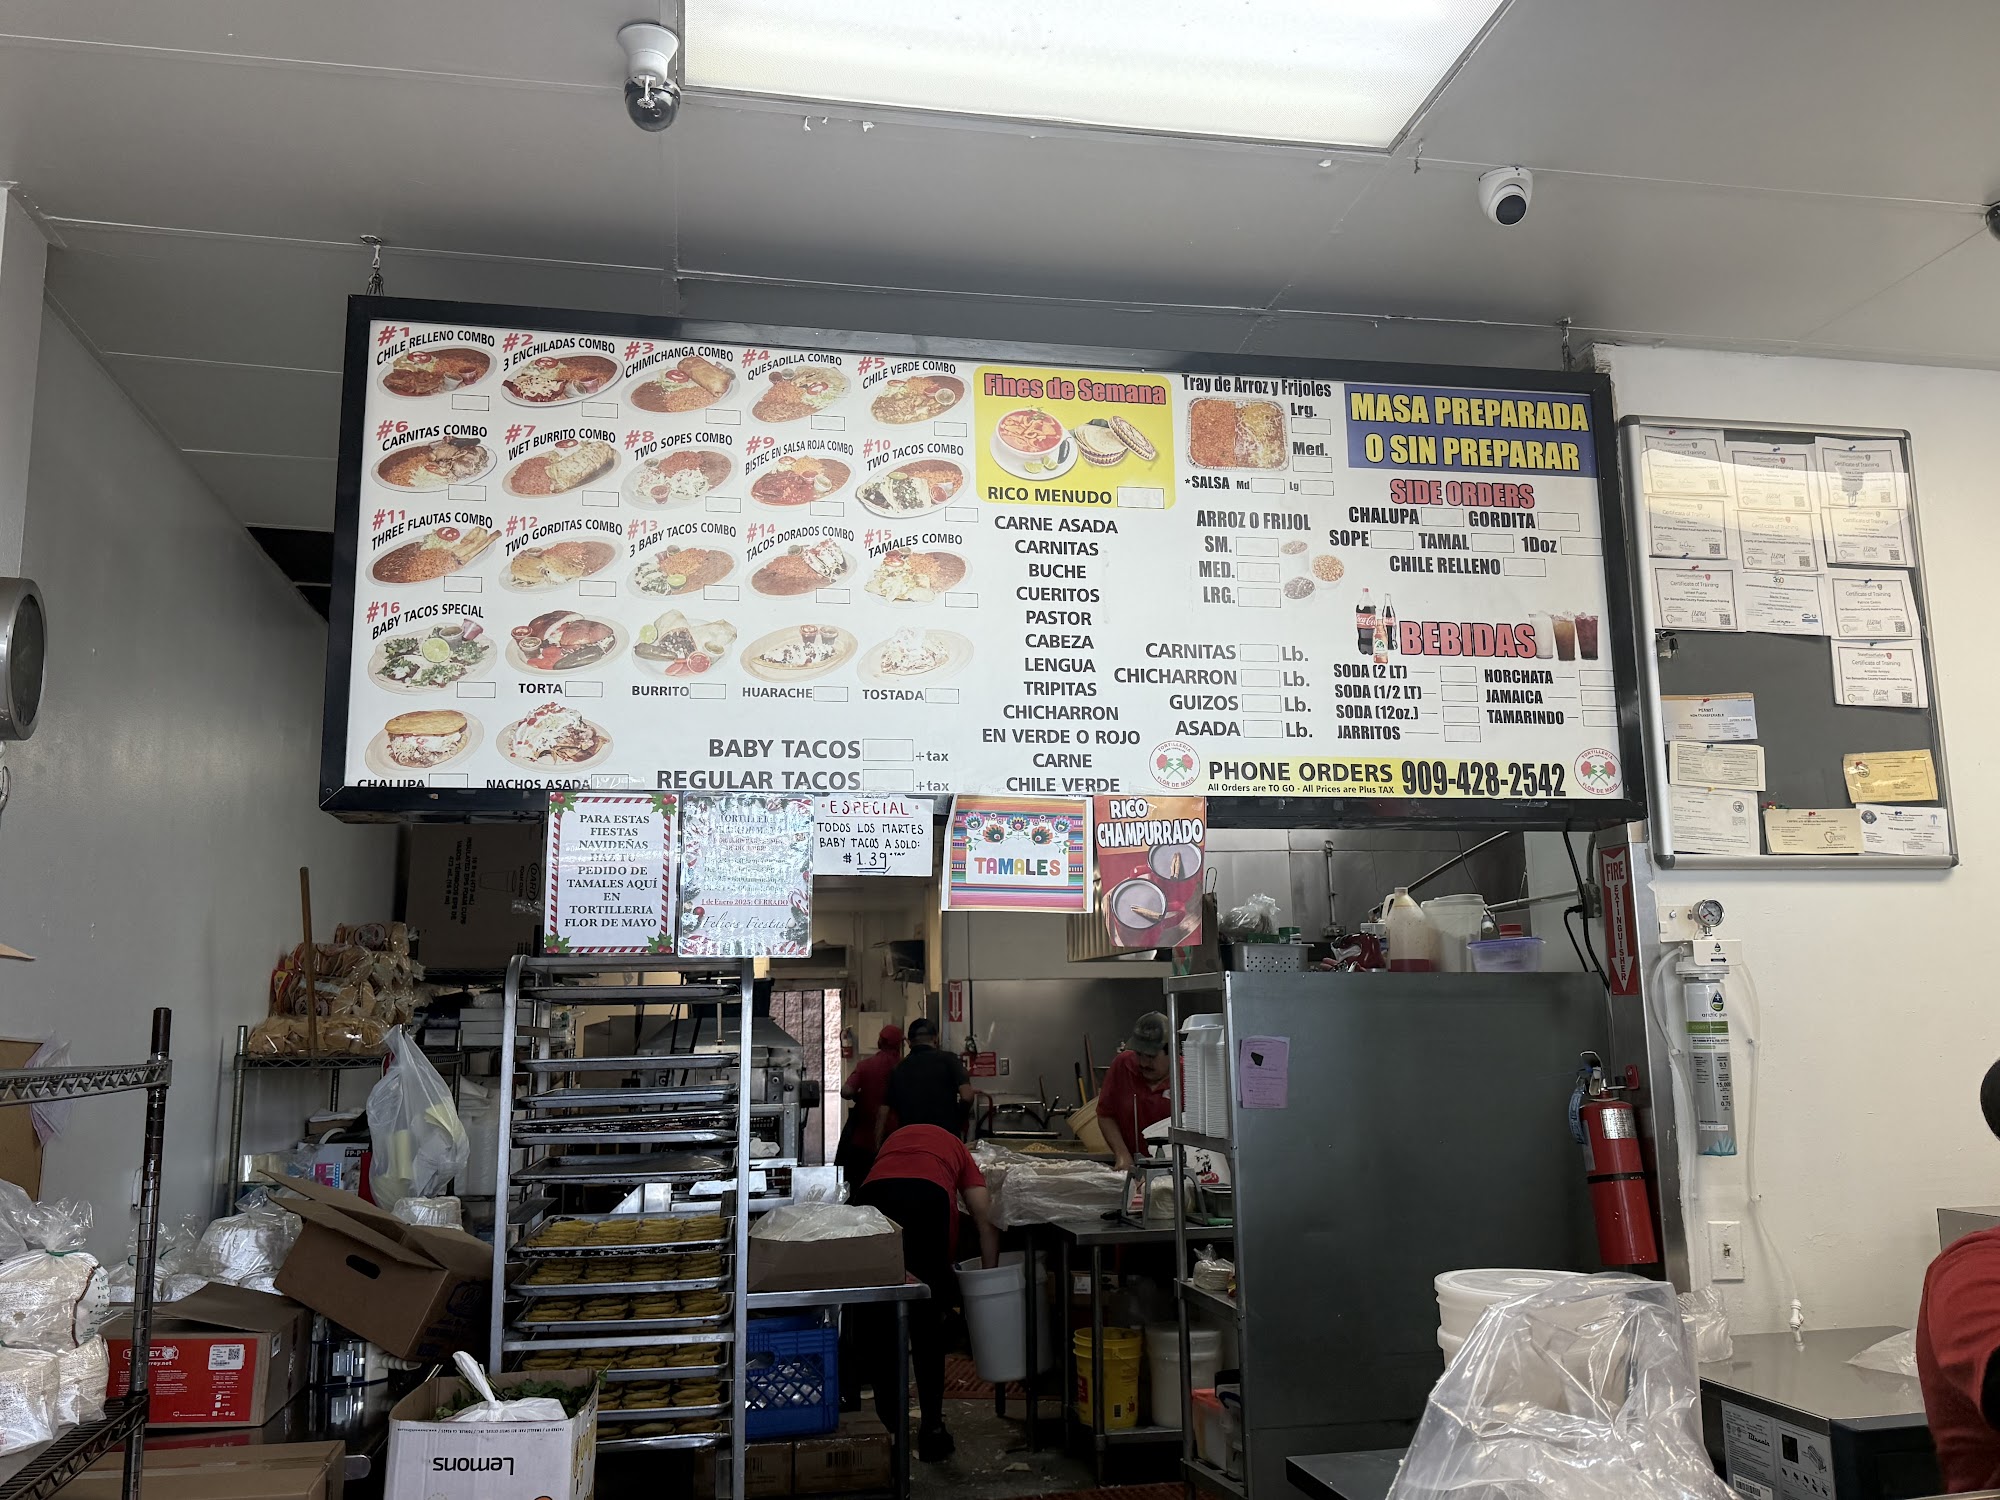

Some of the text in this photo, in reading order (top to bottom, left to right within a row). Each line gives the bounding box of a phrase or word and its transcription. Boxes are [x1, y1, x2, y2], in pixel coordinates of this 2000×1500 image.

[377, 326, 410, 346] #1
[503, 333, 533, 352] #2
[377, 330, 495, 366] CHILE RELLENO COMBO
[504, 338, 615, 371] 3 ENCHILADAS COMBO
[624, 341, 654, 360] #3
[625, 346, 734, 379] CHIMICHANGA COMBO
[858, 357, 885, 375] #5
[862, 361, 956, 390] CHILE VERDE COMBO
[984, 372, 1166, 405] Fines de Semana
[1182, 374, 1332, 397] Tray de Arroz y Frijoles
[1291, 403, 1317, 418] Lrg.
[1350, 392, 1589, 432] MASA PREPARADA
[376, 420, 409, 440] #6
[382, 425, 487, 451] CARNITAS COMBO
[505, 425, 536, 444] #7
[508, 429, 616, 461] WET BURRITO COMBO
[1364, 433, 1580, 471] O SIN PREPARAR
[1237, 480, 1250, 489] Md
[1289, 481, 1299, 491] Lg
[1390, 478, 1535, 509] SIDE ORDERS
[988, 487, 1112, 504] RICO MENUDO
[994, 515, 1119, 534] CARNE ASADA
[1348, 506, 1420, 525] CHALUPA
[1468, 511, 1536, 529] GORDITA
[1419, 533, 1470, 550] TAMAL
[1521, 536, 1557, 554] 1Doz
[1028, 564, 1087, 579] BUCHE
[367, 602, 400, 624] #16
[372, 604, 484, 640] BABY TACOS SPECIAL
[1399, 620, 1537, 659] BEBIDAS
[1025, 657, 1096, 673] LENGUA
[1333, 664, 1370, 679] SODA
[1389, 665, 1407, 679] LT)
[1114, 668, 1310, 688] CHICHARRON Lb.
[1484, 669, 1554, 684] HORCHATA
[518, 683, 562, 694] TORTA
[632, 685, 689, 697] BURRITO
[742, 687, 813, 699] HUARACHE
[863, 689, 924, 701] TOSTADA
[1486, 690, 1543, 705] JAMAICA
[1003, 704, 1119, 720] CHICHARRON
[1336, 705, 1419, 720] SODA (12oz.)
[1487, 709, 1564, 725] TAMARINDO
[1337, 725, 1401, 740] JARRITOS
[709, 739, 861, 759] BABY TACOS
[915, 750, 949, 762] +tax
[1158, 743, 1190, 752] TORTILLERIA
[657, 770, 861, 790] REGULAR TACOS
[1209, 761, 1393, 782] PHONE ORDERS
[1401, 760, 1566, 797] 909-428-2542
[1158, 776, 1169, 786] FLOR
[1208, 784, 1219, 792] All
[1221, 783, 1250, 792] Orders
[1269, 784, 1280, 792] TO
[1302, 785, 1314, 793] All
[1316, 785, 1340, 794] Prices
[1359, 785, 1376, 794] Plus
[1378, 786, 1394, 794] TAX
[830, 801, 909, 815] ESPECIAL
[1109, 799, 1148, 819] RICO
[580, 815, 649, 823] PARA ESTAS
[590, 828, 638, 836] FIESTAS
[817, 823, 924, 834] TODOS LOS MARTES
[1097, 817, 1204, 848] CHAMPURRADO
[579, 839, 648, 849] NAVIDEÑAS
[820, 838, 920, 849] BABY TACOS A SOLO:
[578, 866, 647, 875] PEDIDO DE
[974, 856, 1061, 876] TAMALES
[1606, 861, 1624, 881] FIRE
[567, 878, 657, 890] TAMALES AQUÍ
[569, 906, 653, 914] TORTILLERIA
[564, 919, 657, 927] FLOR DE MAYO
[702, 911, 739, 929] Felices
[1614, 885, 1626, 980] EXTINGUISHER
[432, 1457, 514, 1475] Lemons
